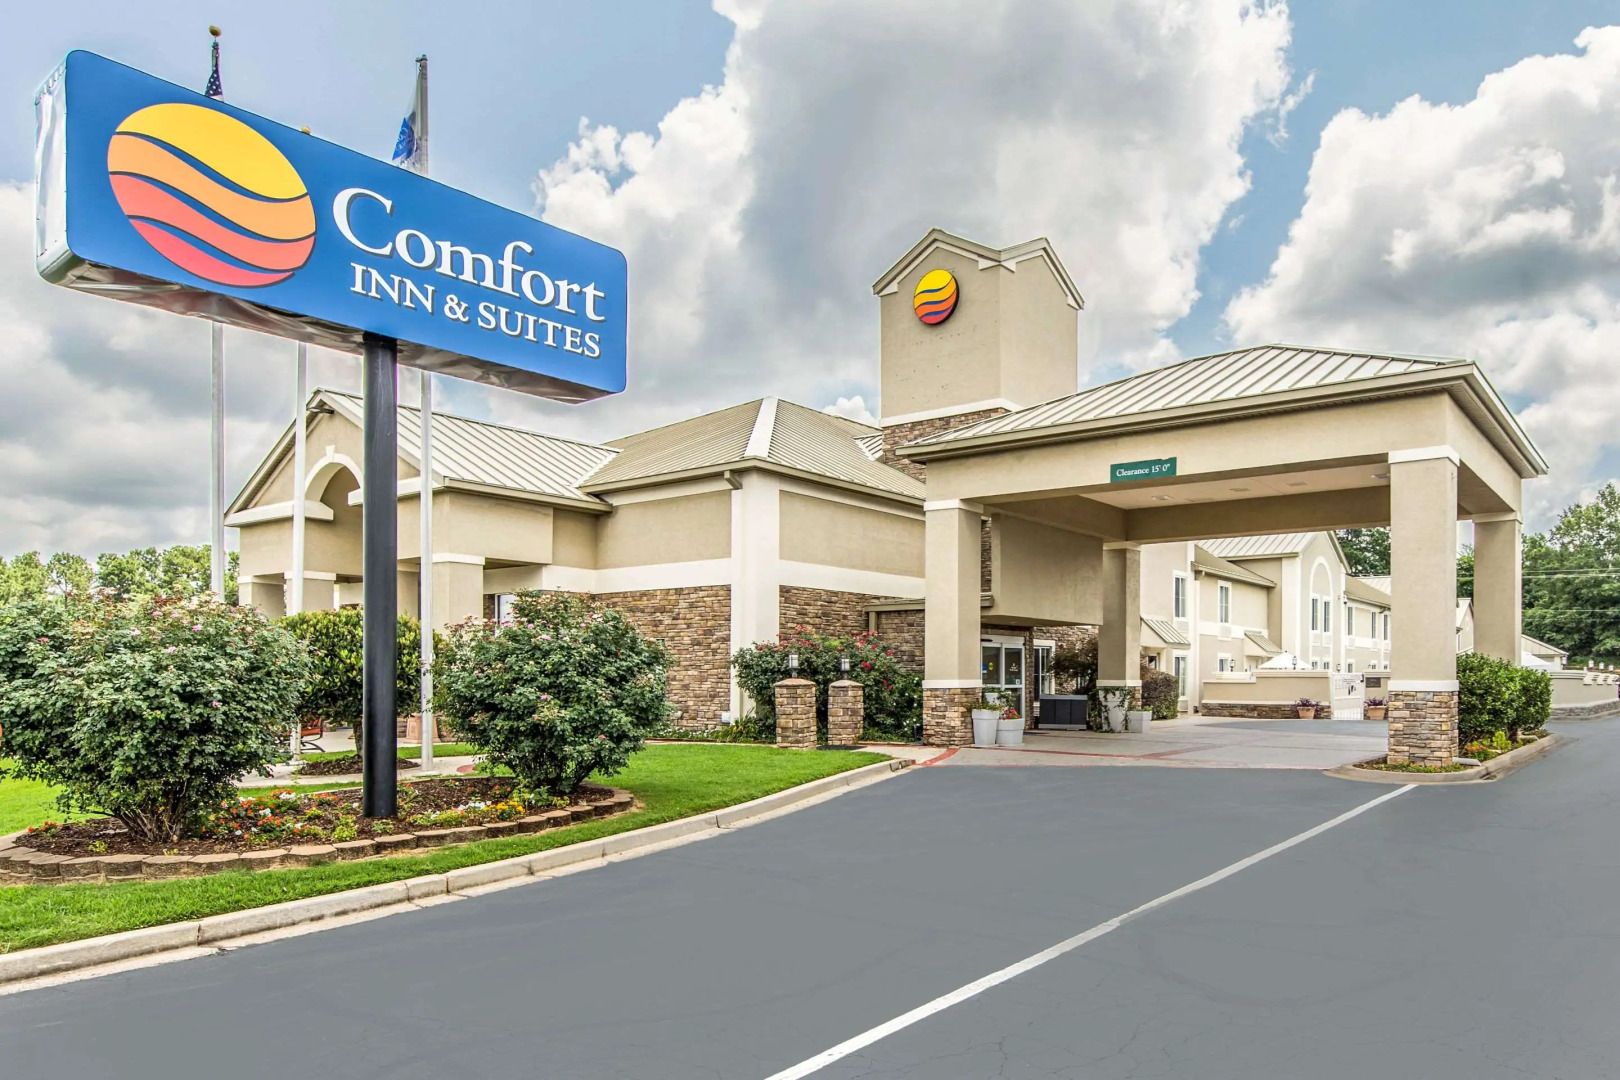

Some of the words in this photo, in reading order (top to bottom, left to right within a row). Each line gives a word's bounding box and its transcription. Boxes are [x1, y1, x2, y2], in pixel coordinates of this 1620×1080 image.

[332, 187, 605, 322] Comfort
[350, 262, 435, 314] INN
[443, 294, 469, 322] &
[477, 301, 601, 358] SUITES
[1116, 468, 1149, 477] Clearance
